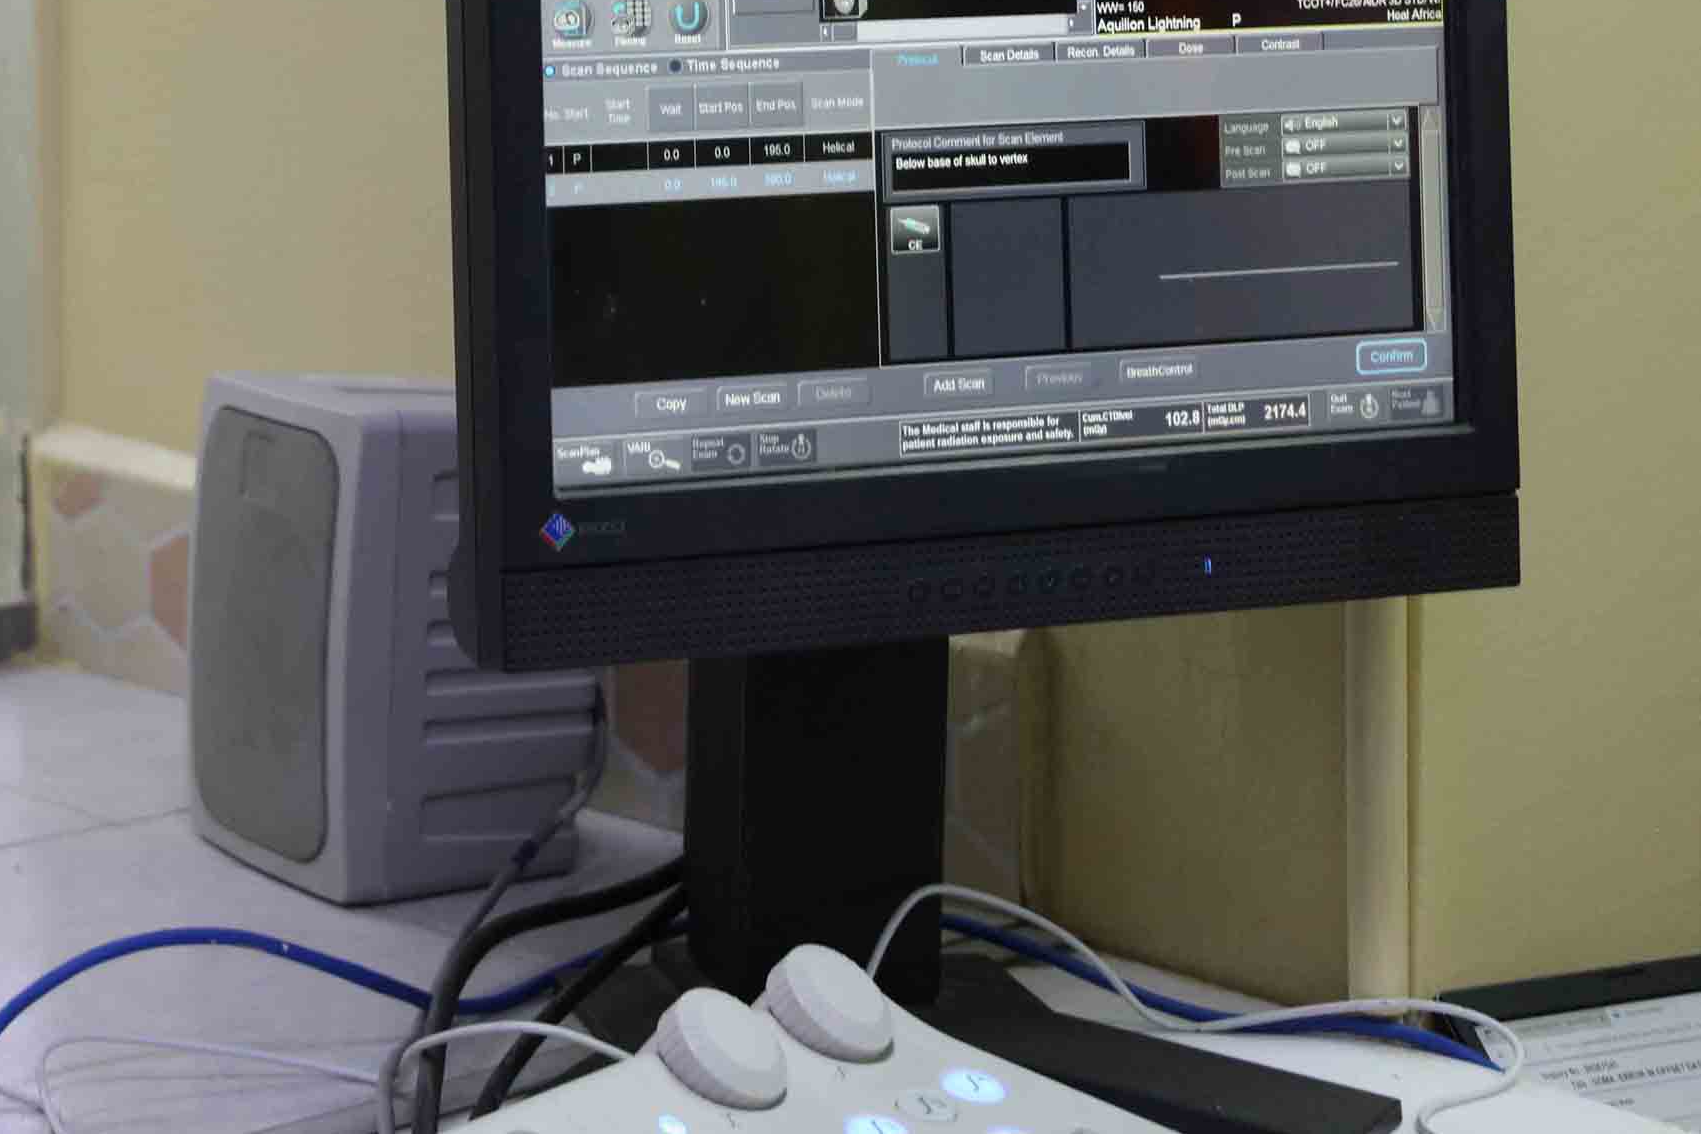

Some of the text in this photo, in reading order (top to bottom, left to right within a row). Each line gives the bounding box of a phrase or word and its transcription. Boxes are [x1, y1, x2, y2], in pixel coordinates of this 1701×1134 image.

[1231, 13, 1242, 27] P
[1411, 8, 1442, 21] Africa
[1097, 15, 1201, 34] Aquilion Lightning
[1067, 44, 1136, 59] Recon Details
[1178, 42, 1204, 55] Dose
[1260, 38, 1300, 51] Contrast
[979, 48, 1040, 62] Scan Details
[561, 62, 658, 77] Scan Sequence
[687, 56, 780, 73] Time Sequence
[659, 103, 682, 115] Wait
[699, 101, 744, 115] Start Pos
[755, 98, 797, 112] End Pos
[1223, 122, 1270, 136] Language
[1305, 116, 1339, 131] English
[822, 140, 856, 155] Helical
[891, 130, 1064, 151] Protocol Comment for Scan Element
[1305, 139, 1327, 152] OFF
[663, 148, 681, 162] 0.0
[714, 146, 731, 159] 0.0
[895, 152, 1029, 171] Below base of skull to vertex
[1306, 162, 1327, 175] OFF
[1370, 348, 1414, 364] Confirm
[933, 377, 986, 393] Add Scan
[656, 396, 687, 413] Copy
[724, 391, 781, 407] New Scan
[1264, 401, 1307, 421] 2174.4
[902, 424, 920, 437] The
[922, 421, 960, 436] Medical
[961, 420, 982, 433] staff
[992, 415, 1045, 434] responsible
[1046, 415, 1060, 428] for
[902, 438, 936, 453] patient
[937, 434, 979, 448] radiation
[980, 430, 1023, 446] exposure
[1025, 428, 1043, 442] and
